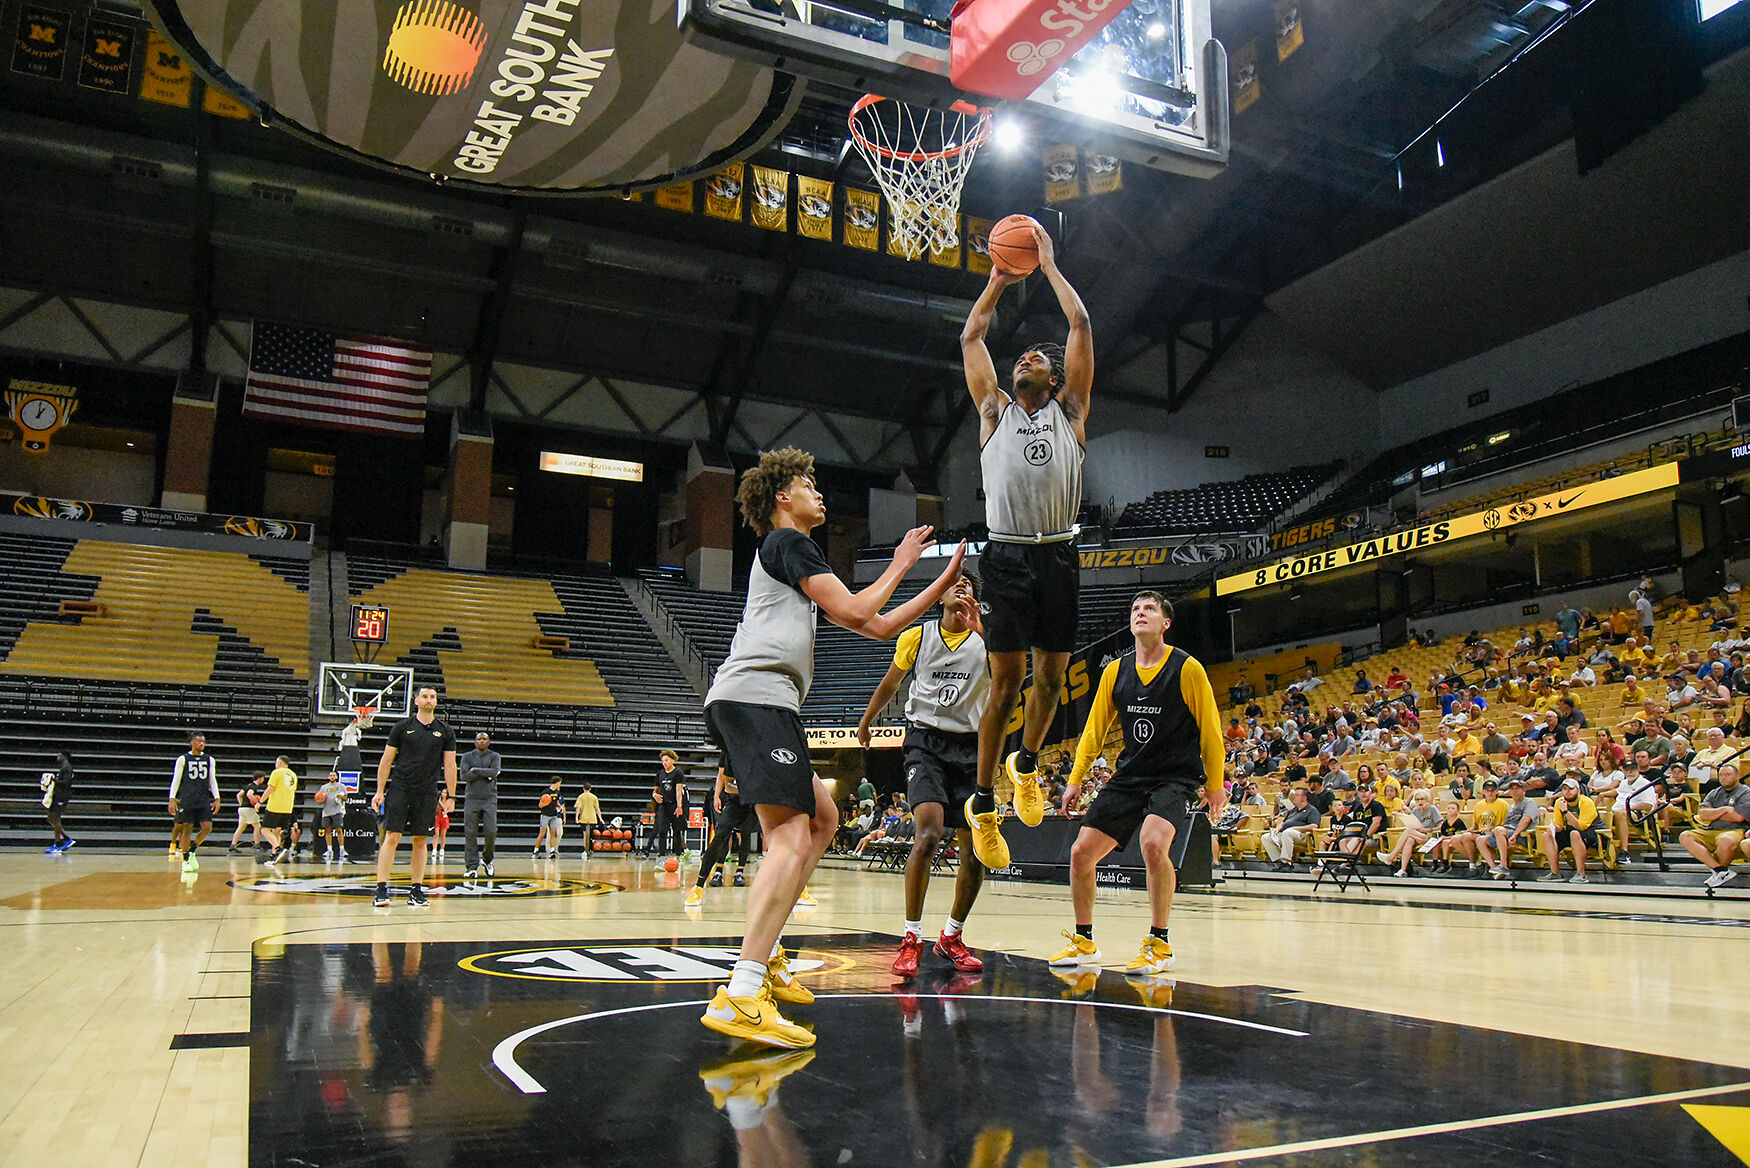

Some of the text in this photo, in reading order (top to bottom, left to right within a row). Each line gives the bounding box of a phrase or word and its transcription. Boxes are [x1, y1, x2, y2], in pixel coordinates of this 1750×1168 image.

[531, 38, 615, 126] BANK
[453, 100, 523, 174] GREAT
[805, 186, 827, 197] NCAA
[1030, 443, 1047, 460] 23
[623, 466, 641, 474] BANK
[141, 510, 198, 522] Veterans United
[1247, 517, 1336, 558] SEC TIGERS
[1254, 569, 1267, 586] 8
[1275, 551, 1337, 581] CORE
[1346, 522, 1450, 563] VALUES
[1484, 509, 1501, 529] SEC
[1079, 547, 1168, 569] MIZZOU
[357, 619, 381, 639] 20
[932, 671, 971, 680] MIZZOU
[1127, 705, 1162, 715] MIZZOU
[829, 730, 846, 738] TO
[1137, 723, 1148, 738] 13
[188, 760, 208, 780] 55
[355, 829, 374, 837] Care
[1096, 871, 1132, 884] Health Care
